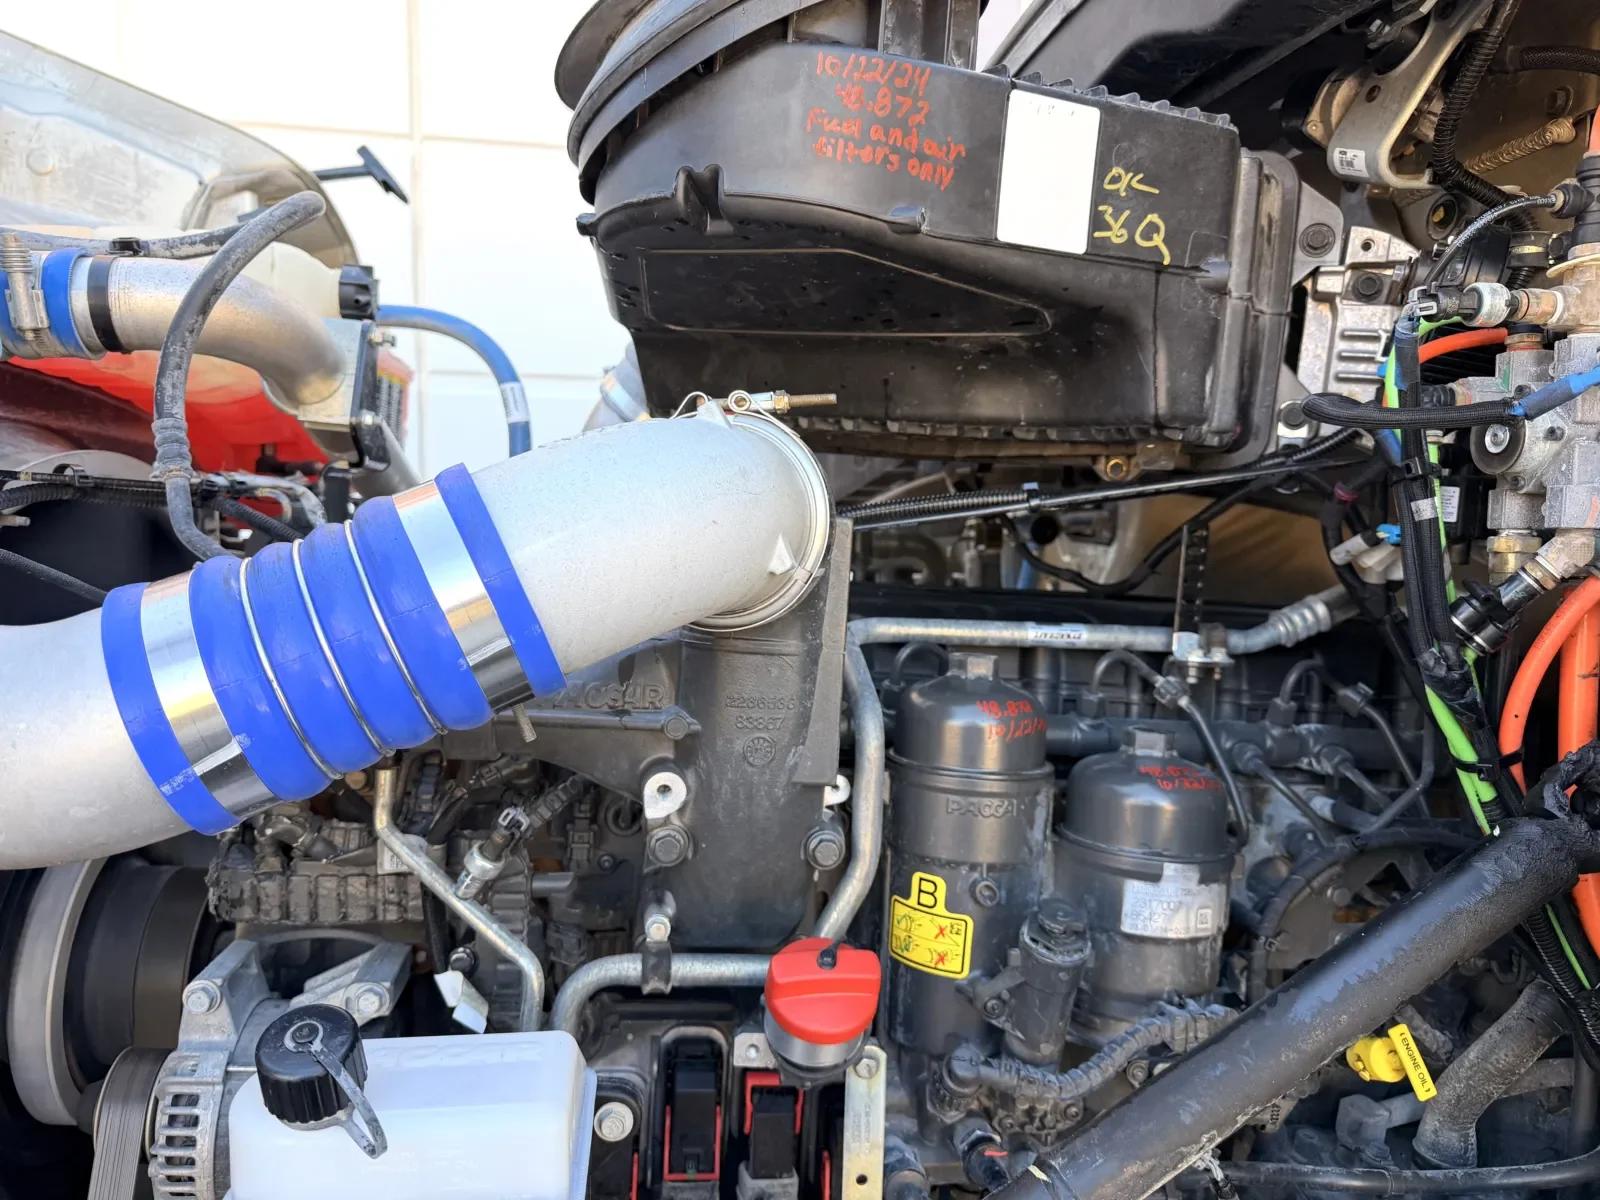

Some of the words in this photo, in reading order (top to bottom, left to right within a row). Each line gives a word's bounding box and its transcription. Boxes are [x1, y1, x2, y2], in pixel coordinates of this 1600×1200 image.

[870, 124, 919, 153] and
[923, 136, 966, 160] air
[907, 157, 954, 192] only
[1103, 167, 1160, 196] OK
[917, 877, 938, 909] B
[1401, 1038, 1421, 1071] ENGINE
[1417, 1072, 1429, 1087] OIL
